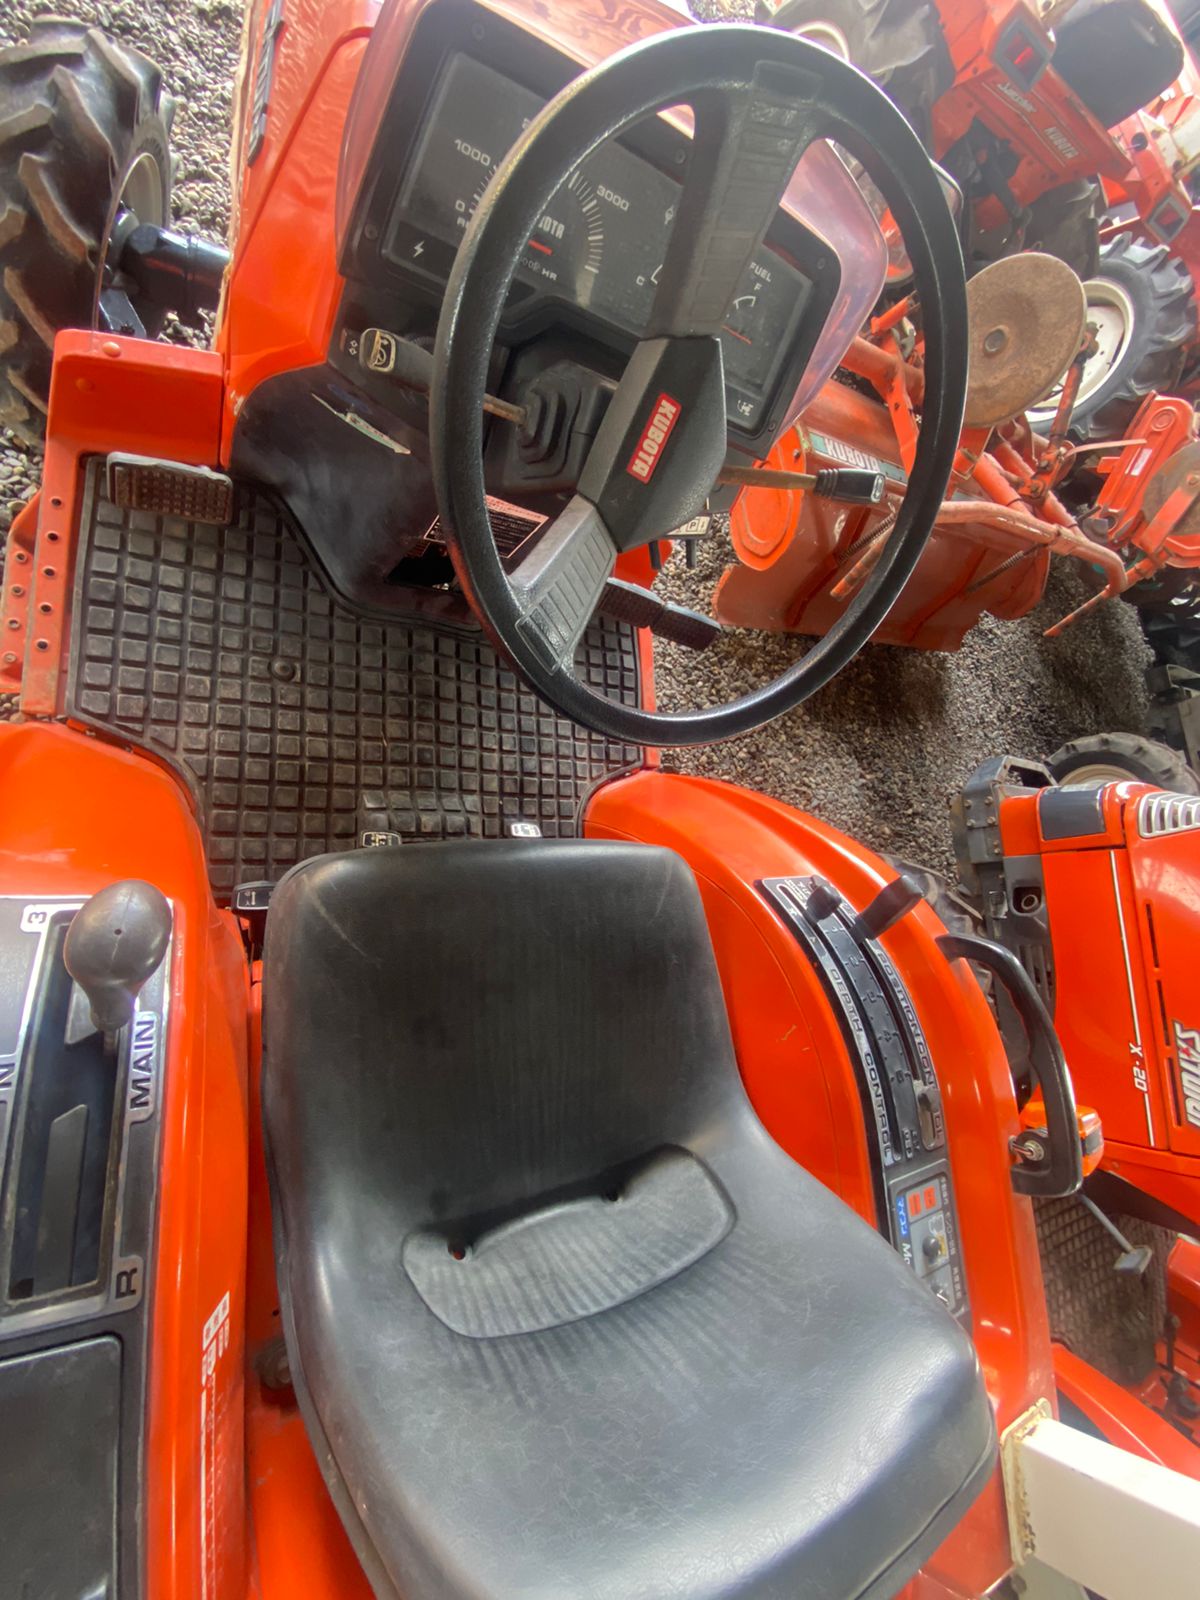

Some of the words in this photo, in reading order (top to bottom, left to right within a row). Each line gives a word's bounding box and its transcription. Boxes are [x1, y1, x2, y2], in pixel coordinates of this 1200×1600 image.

[454, 138, 491, 167] 1000
[596, 184, 630, 212] 3000
[750, 262, 772, 282] FUEL
[632, 400, 677, 478] KUBOTA
[824, 438, 881, 472] KUBOTA
[27, 911, 47, 925] 3
[877, 952, 922, 1037] POSITION
[917, 1041, 943, 1139] CONOL
[130, 1018, 157, 1110] MAIN
[829, 968, 863, 1032] DEPTH
[864, 1052, 893, 1158] CONTROL
[116, 1267, 138, 1300] R
